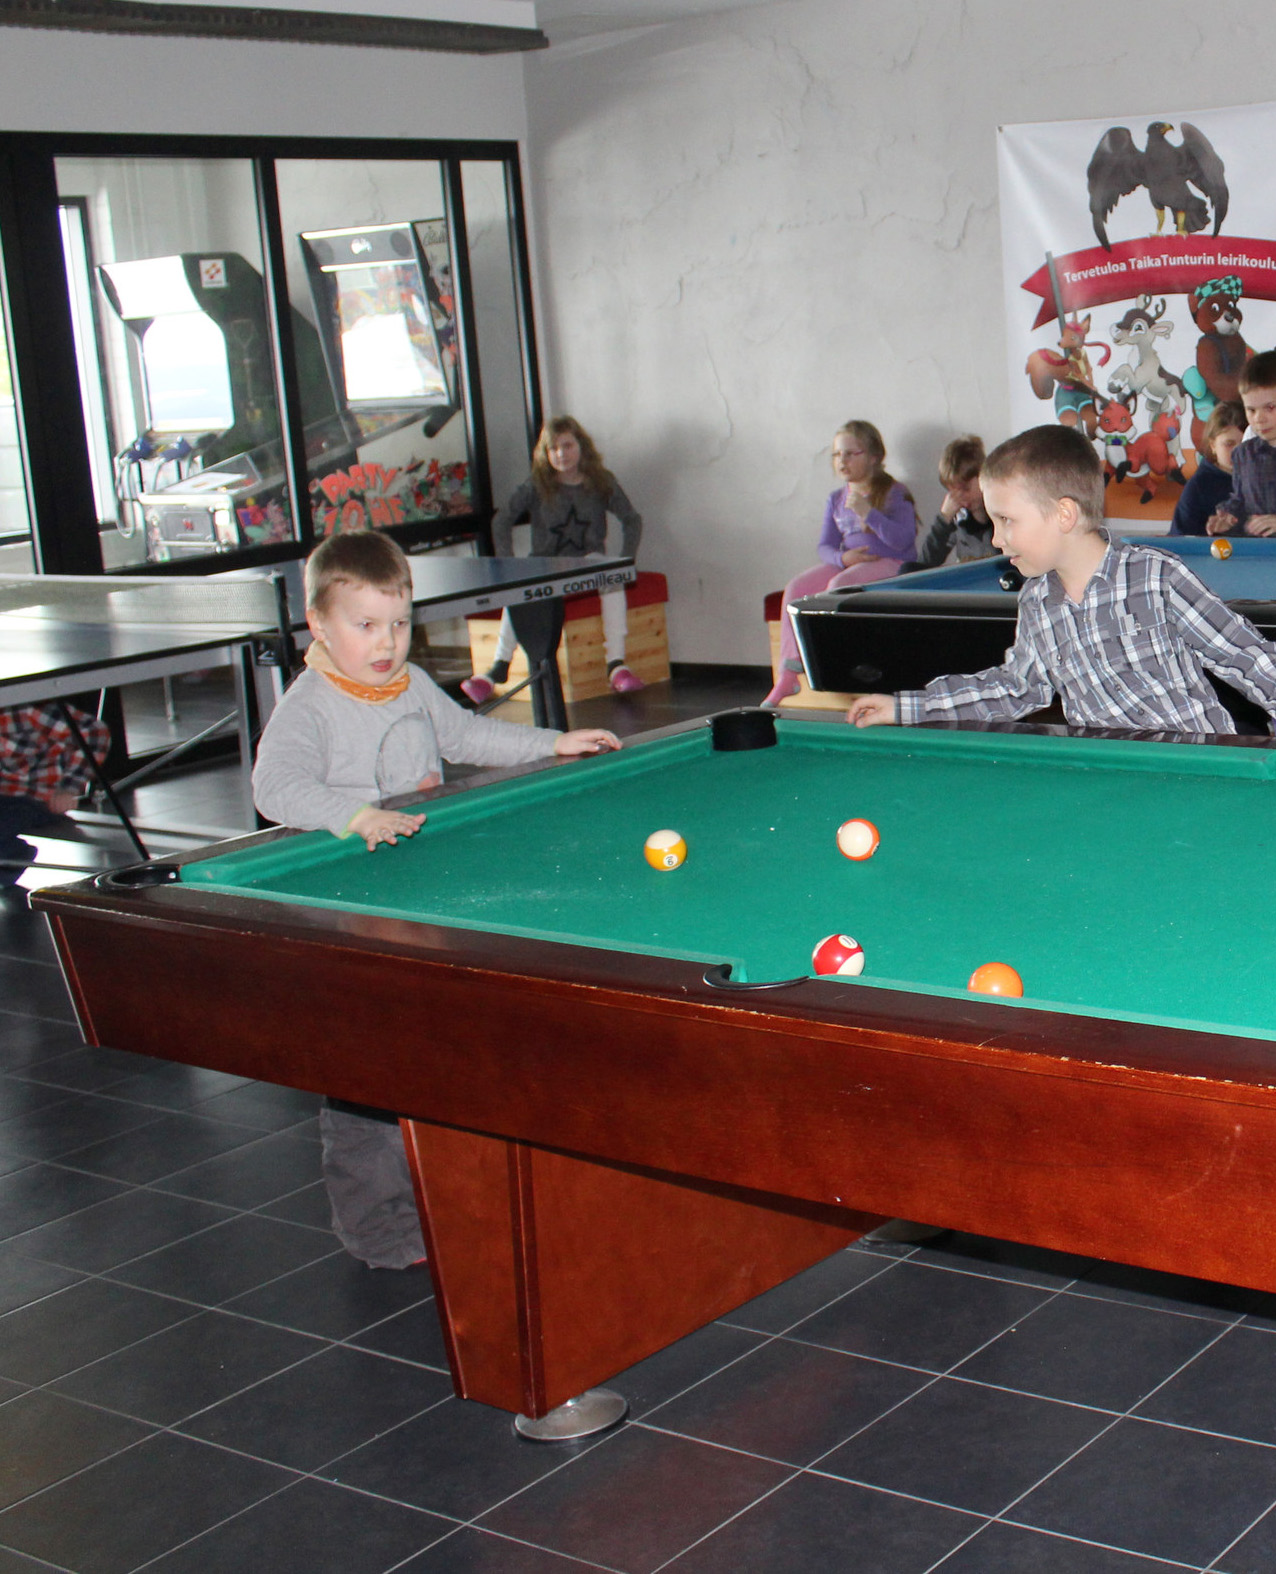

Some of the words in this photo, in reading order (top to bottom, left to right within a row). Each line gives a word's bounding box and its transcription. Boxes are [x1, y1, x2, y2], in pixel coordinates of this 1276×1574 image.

[1063, 262, 1127, 284] Tervetuloa
[1128, 253, 1215, 270] TaikaTunturin
[319, 463, 397, 505] PARTY
[523, 585, 553, 601] 540
[562, 569, 633, 595] cornilleau
